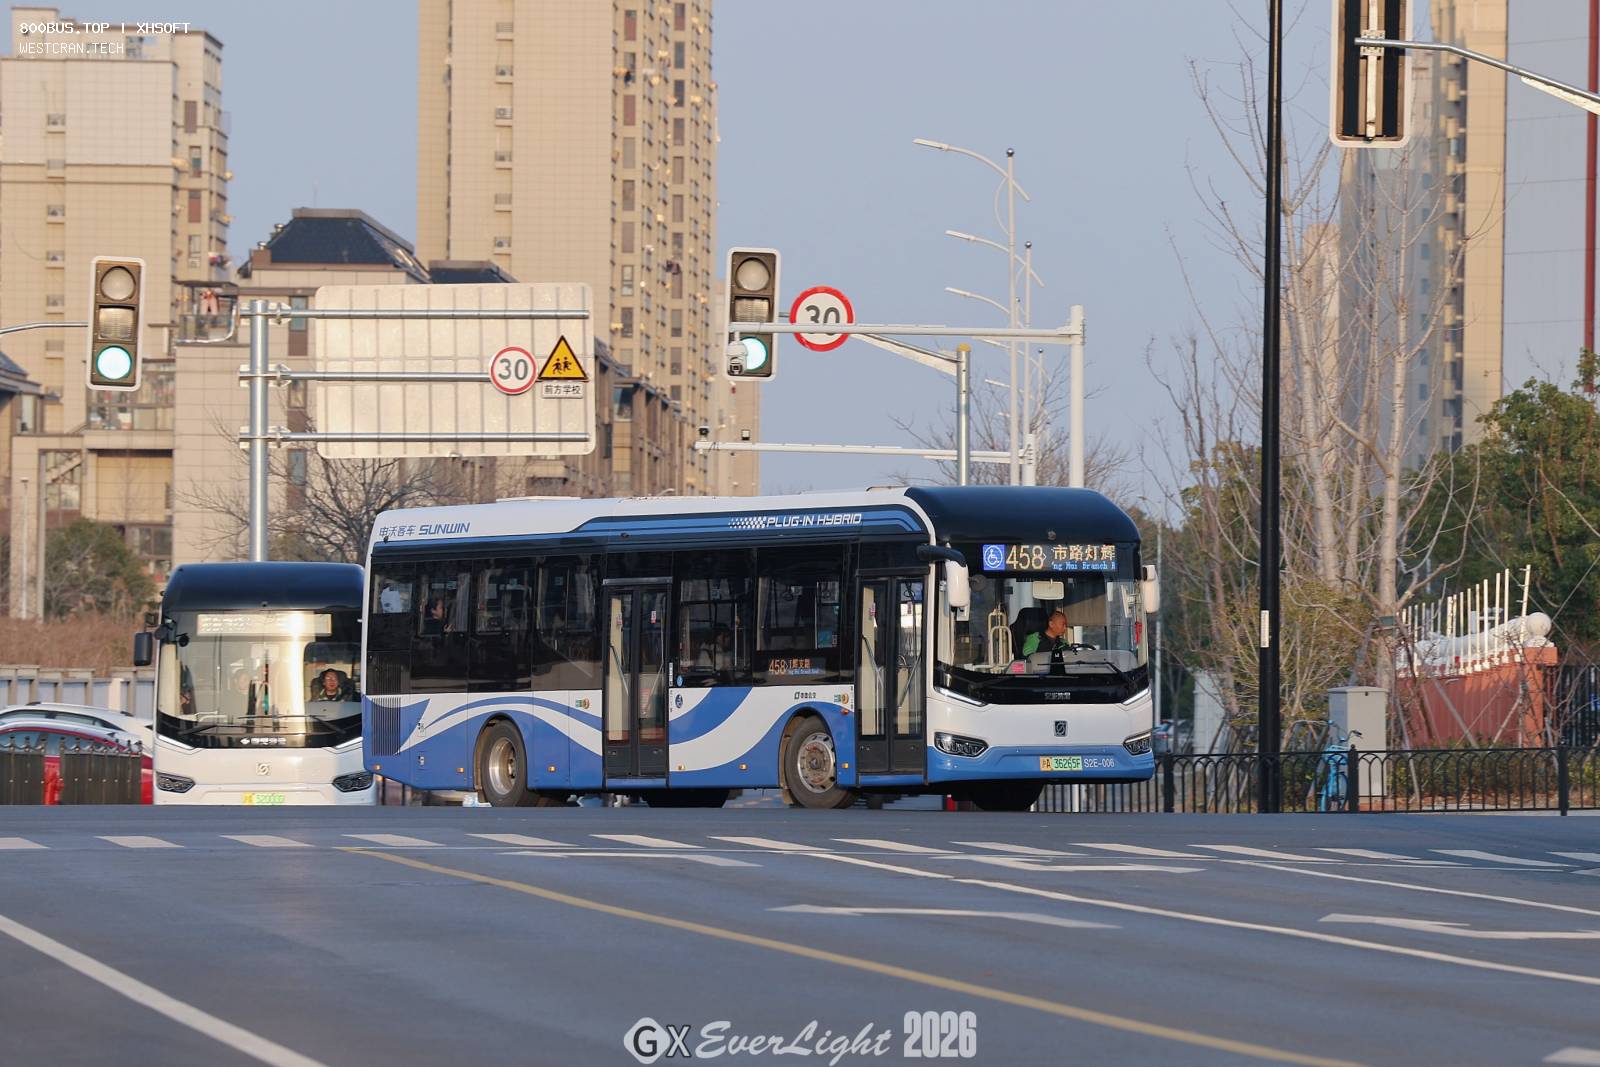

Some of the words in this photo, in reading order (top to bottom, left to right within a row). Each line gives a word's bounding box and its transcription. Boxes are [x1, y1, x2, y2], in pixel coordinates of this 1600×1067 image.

[805, 304, 841, 336] 30
[498, 358, 529, 380] 30
[543, 384, 582, 395] 前方学校
[765, 515, 815, 528] PLUG-IN
[816, 512, 862, 526] HYBRID
[378, 524, 417, 537] 申沃客车
[418, 521, 471, 536] SUNWIN
[1005, 544, 1044, 570] 458
[1082, 559, 1108, 570] Branch
[768, 658, 787, 675] 458
